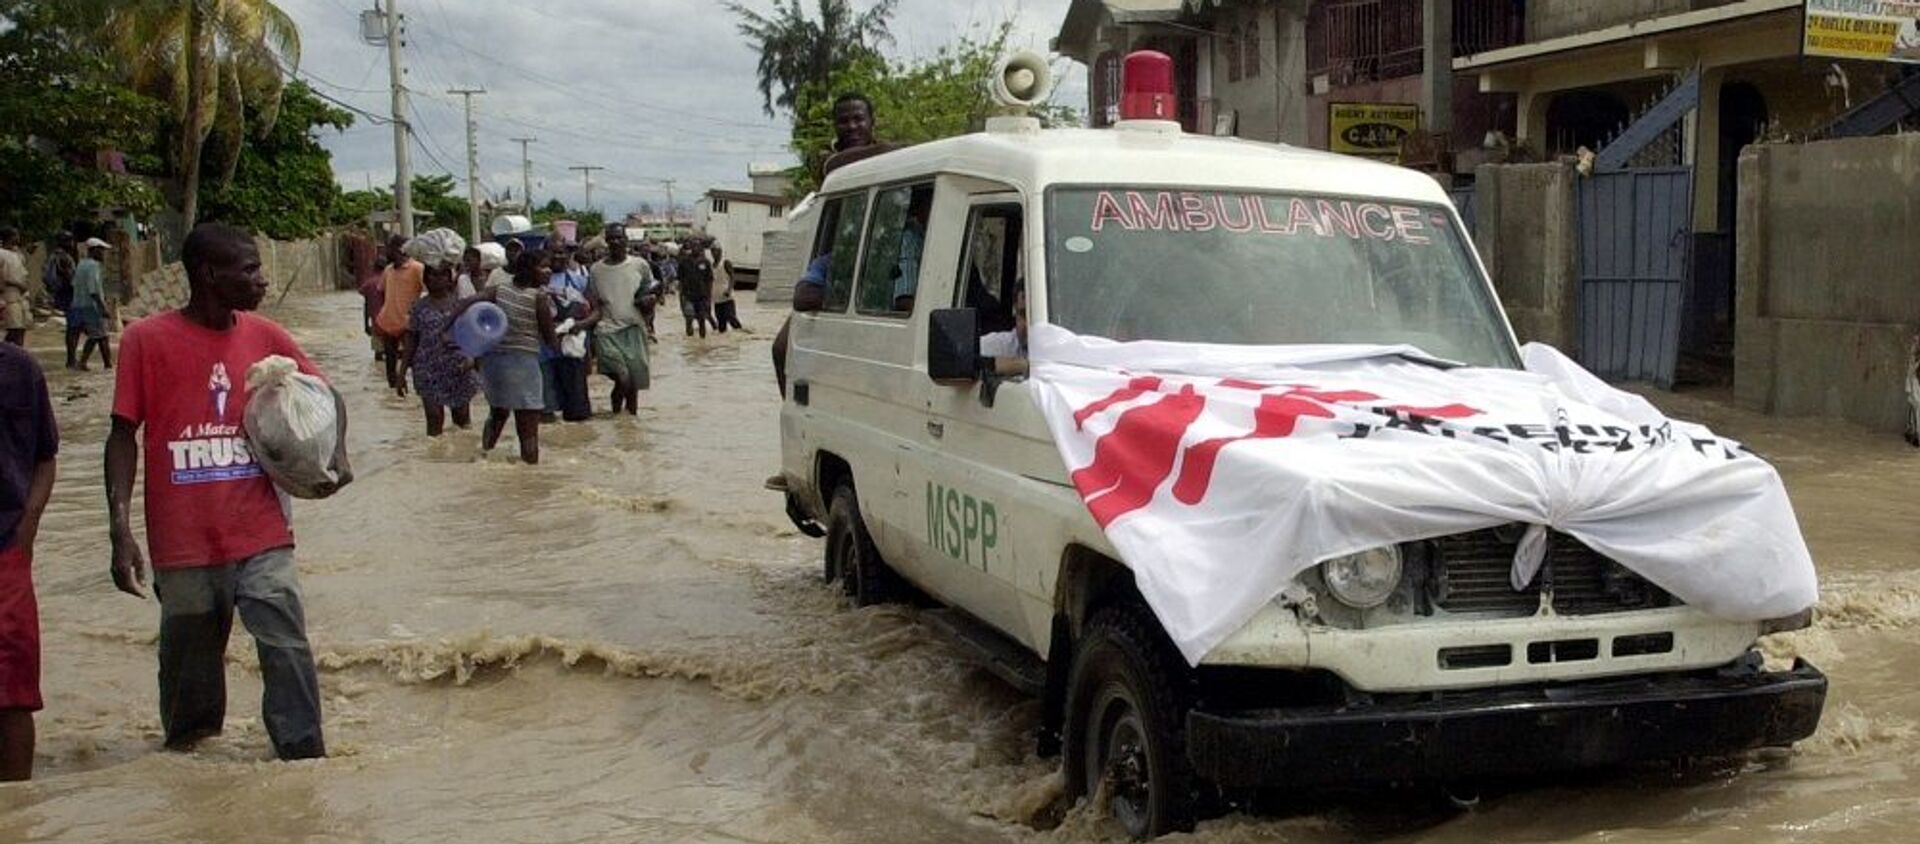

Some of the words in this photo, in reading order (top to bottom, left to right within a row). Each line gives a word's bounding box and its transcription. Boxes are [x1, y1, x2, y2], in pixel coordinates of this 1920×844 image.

[1091, 191, 1430, 244] AMBULANCE
[179, 424, 193, 438] A
[926, 480, 998, 573] MSPP
